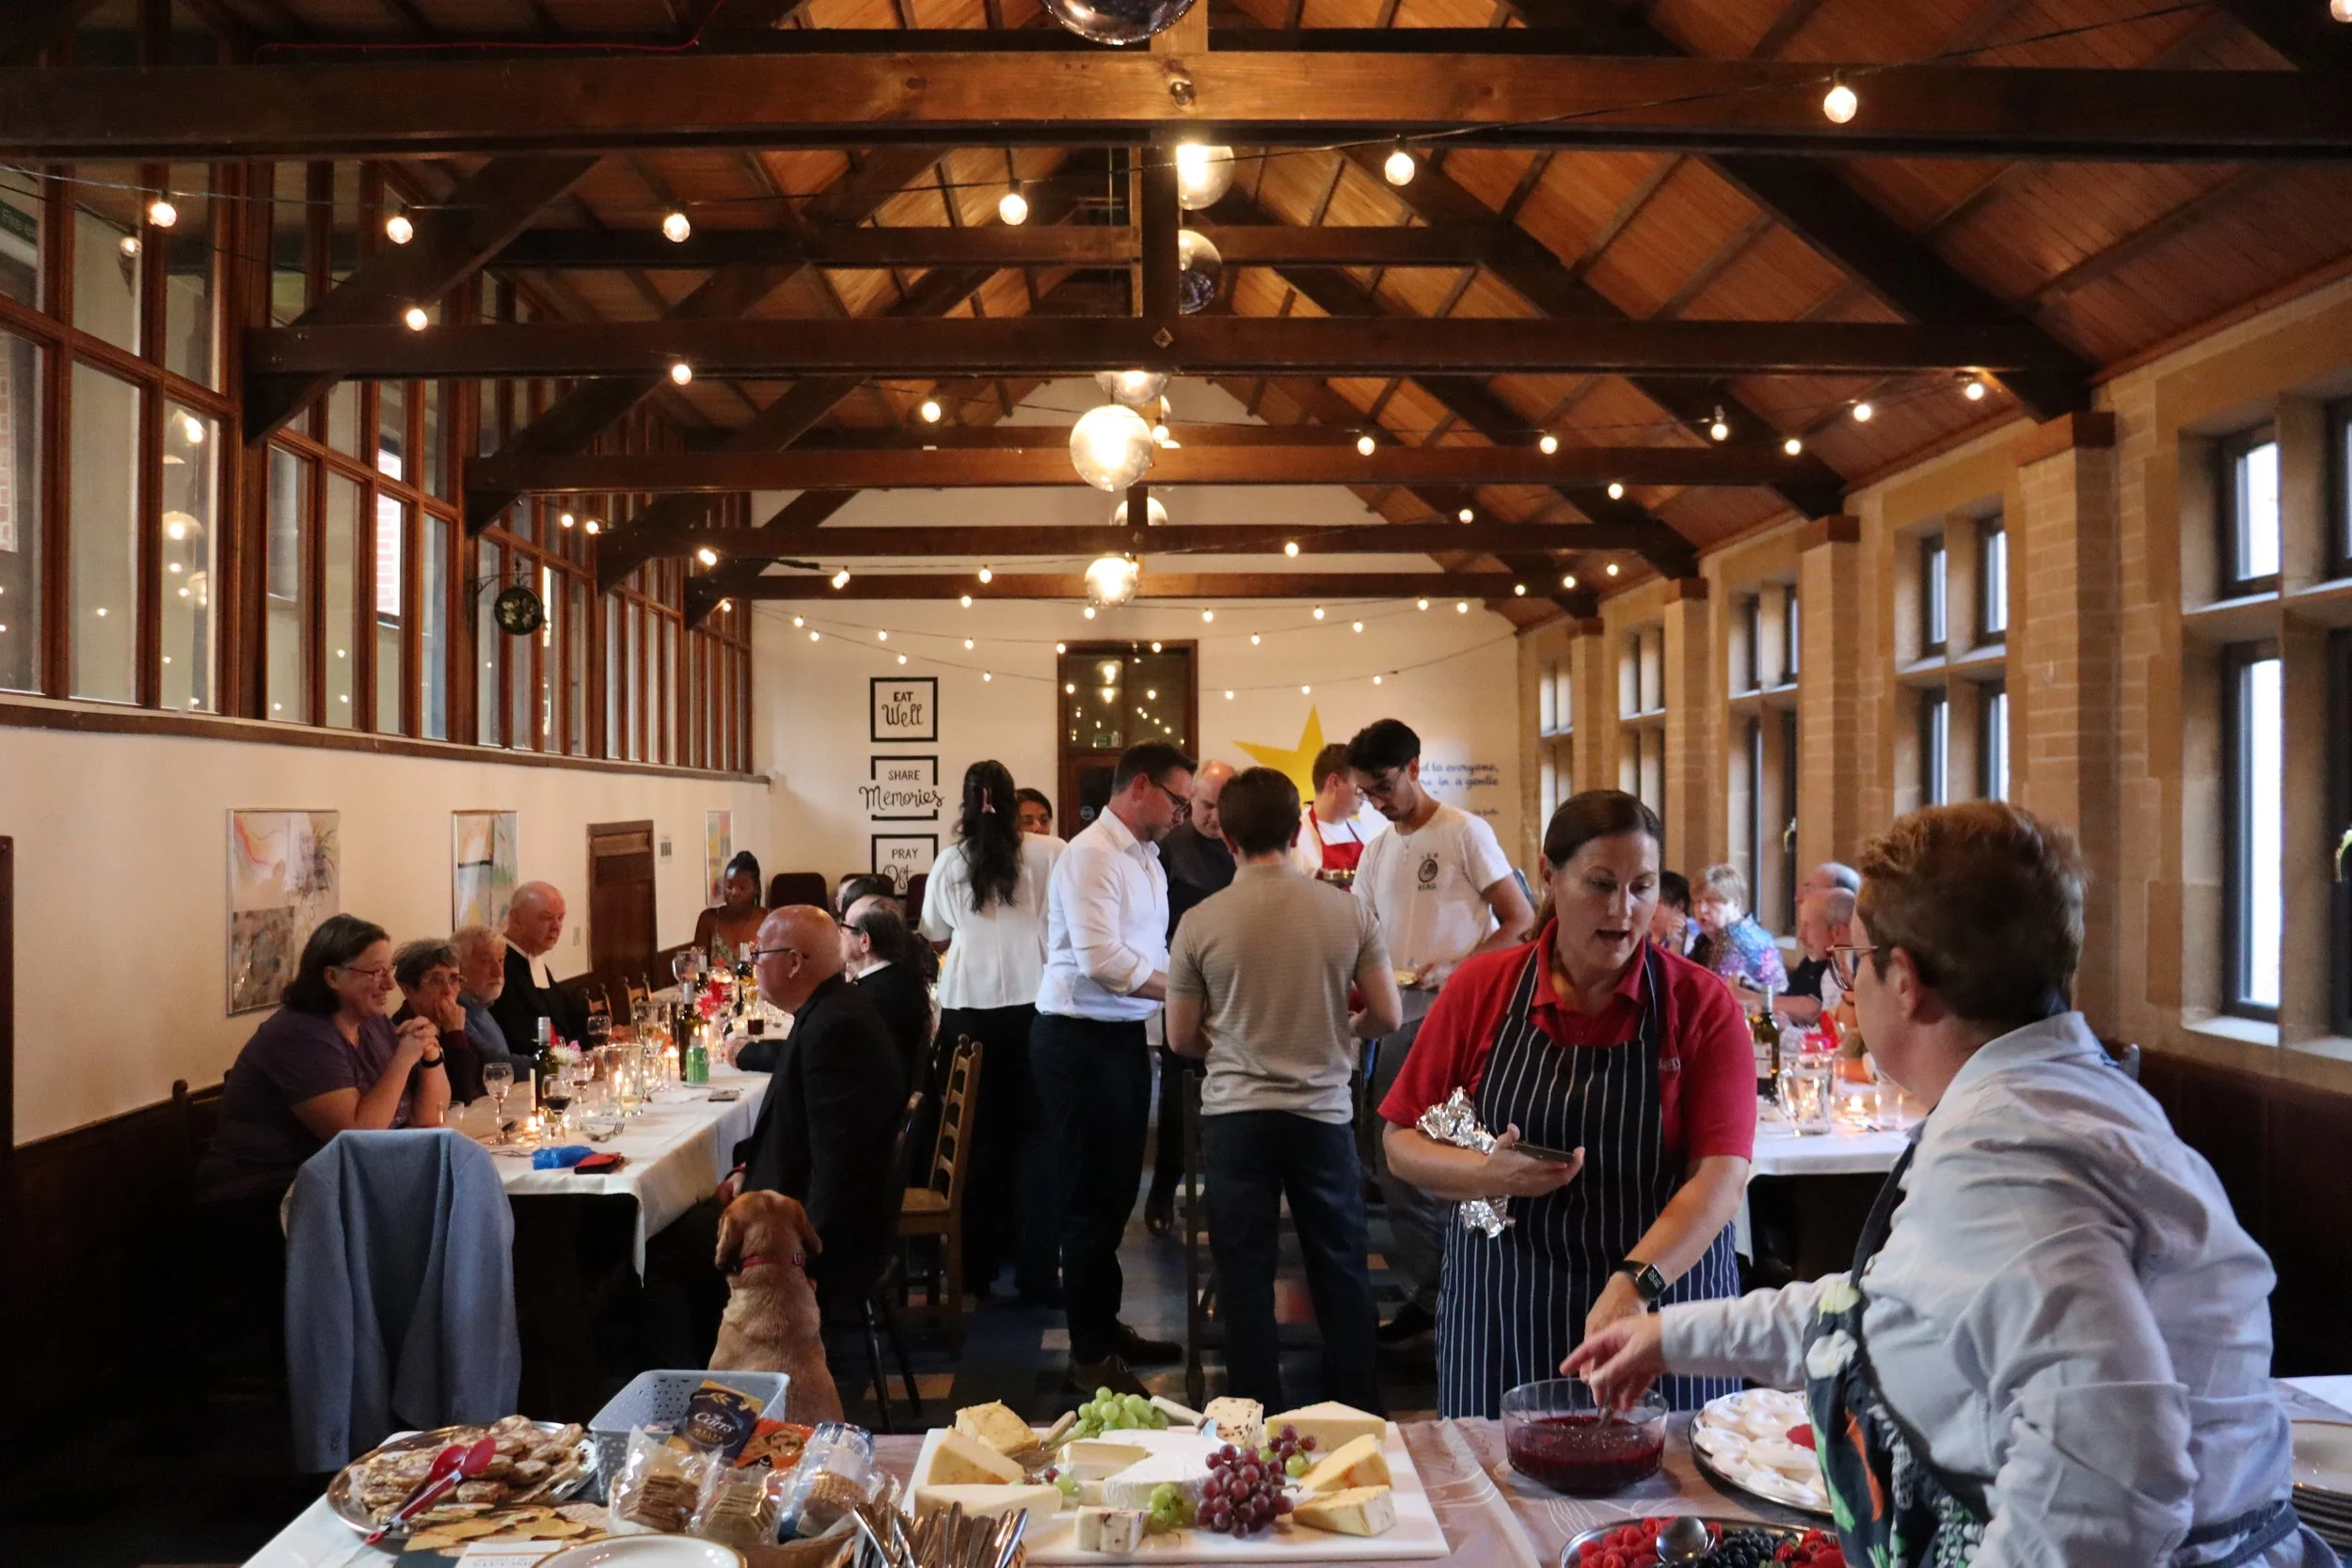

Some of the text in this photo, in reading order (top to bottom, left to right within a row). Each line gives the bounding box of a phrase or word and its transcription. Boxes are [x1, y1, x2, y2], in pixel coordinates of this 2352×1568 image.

[893, 691, 914, 703] EAT
[882, 704, 924, 727] Well
[888, 769, 921, 781] SHARE
[859, 785, 945, 811] Memories
[891, 848, 919, 860] PRAY
